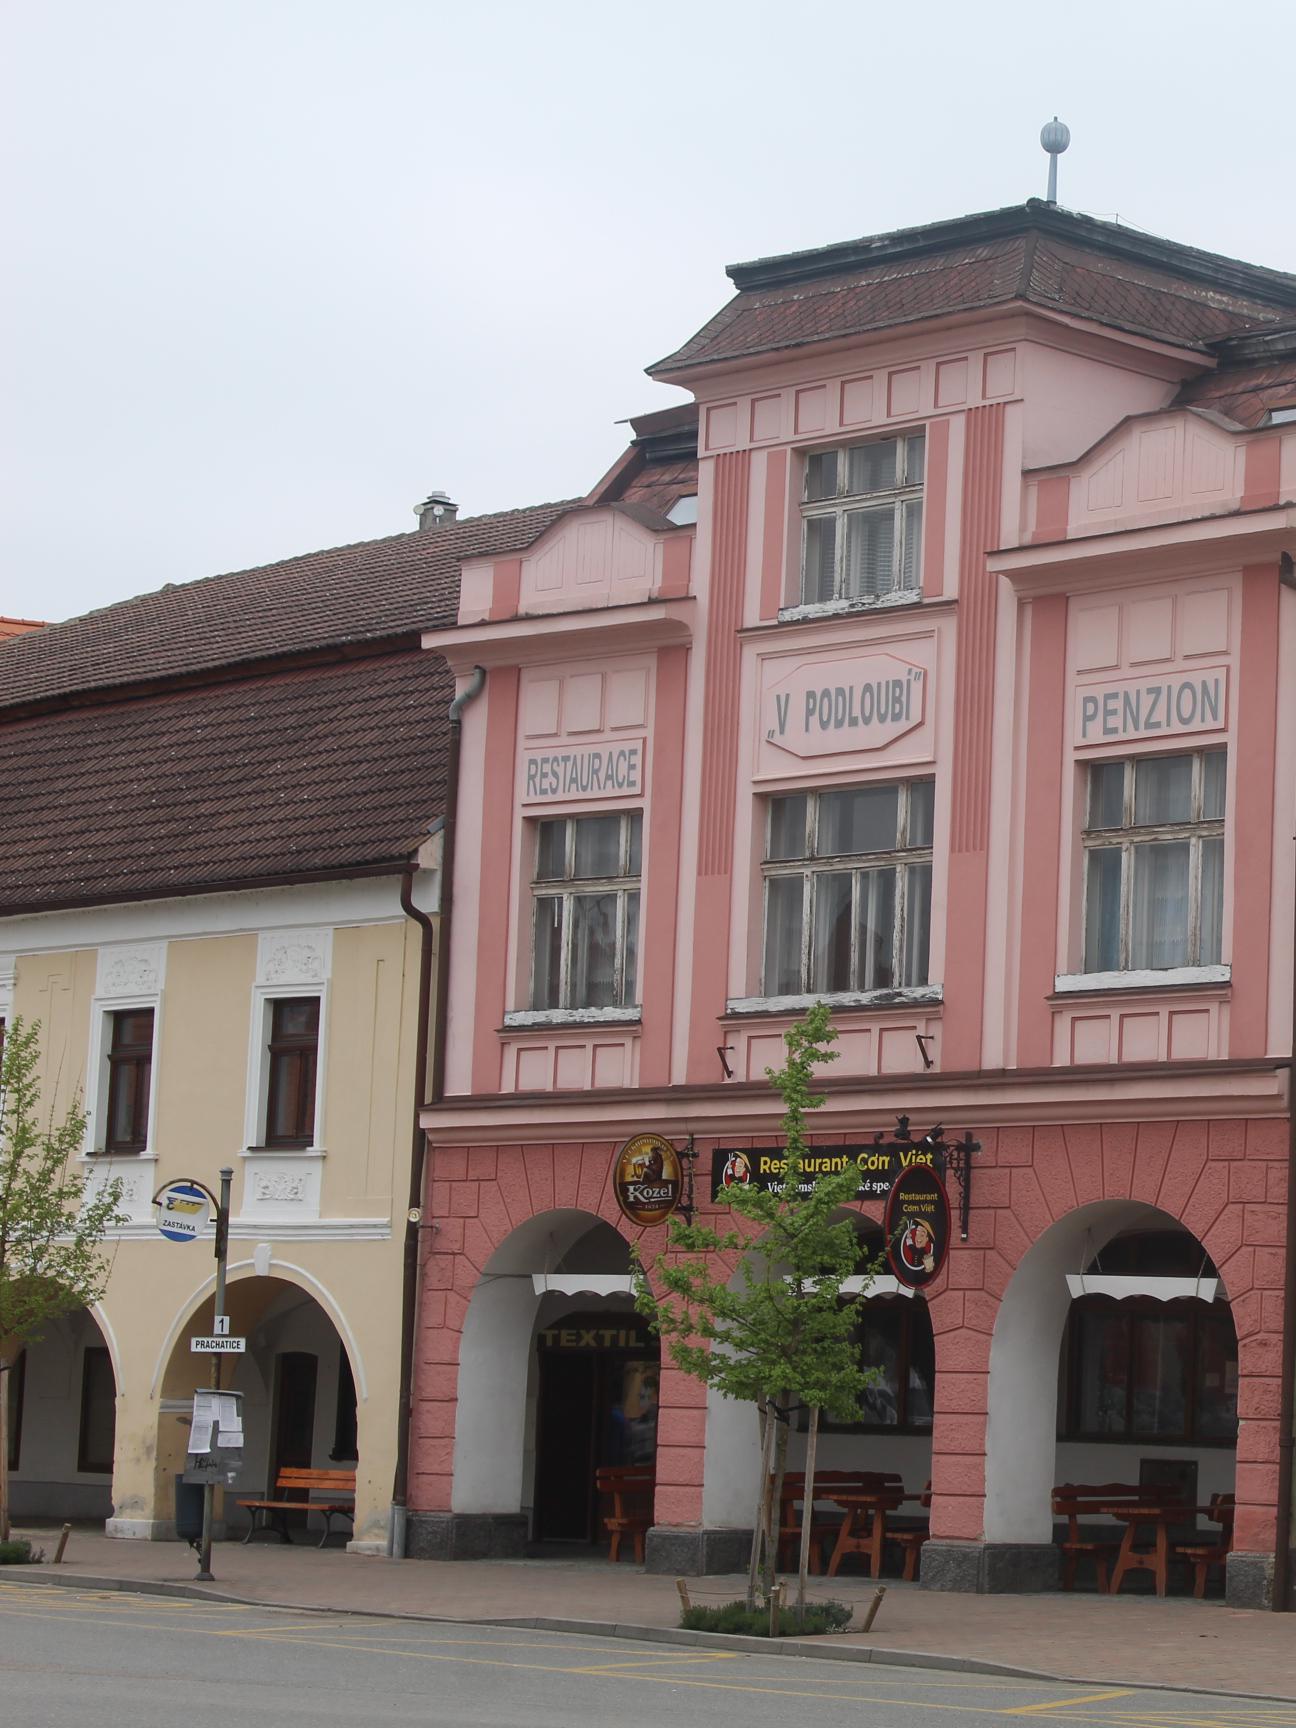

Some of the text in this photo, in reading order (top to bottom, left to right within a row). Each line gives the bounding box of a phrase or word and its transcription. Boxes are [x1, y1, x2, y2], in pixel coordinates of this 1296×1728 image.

[1082, 678, 1219, 738] PENZION
[526, 748, 638, 797] RESTAURACE
[626, 1183, 673, 1203] Kozel
[899, 1192, 938, 1201] Restaurant
[163, 1219, 196, 1232] ZASTÁVKA
[219, 1317, 225, 1333] 1
[195, 1340, 241, 1350] PRACHATICE
[541, 1329, 645, 1347] TEXTIL
